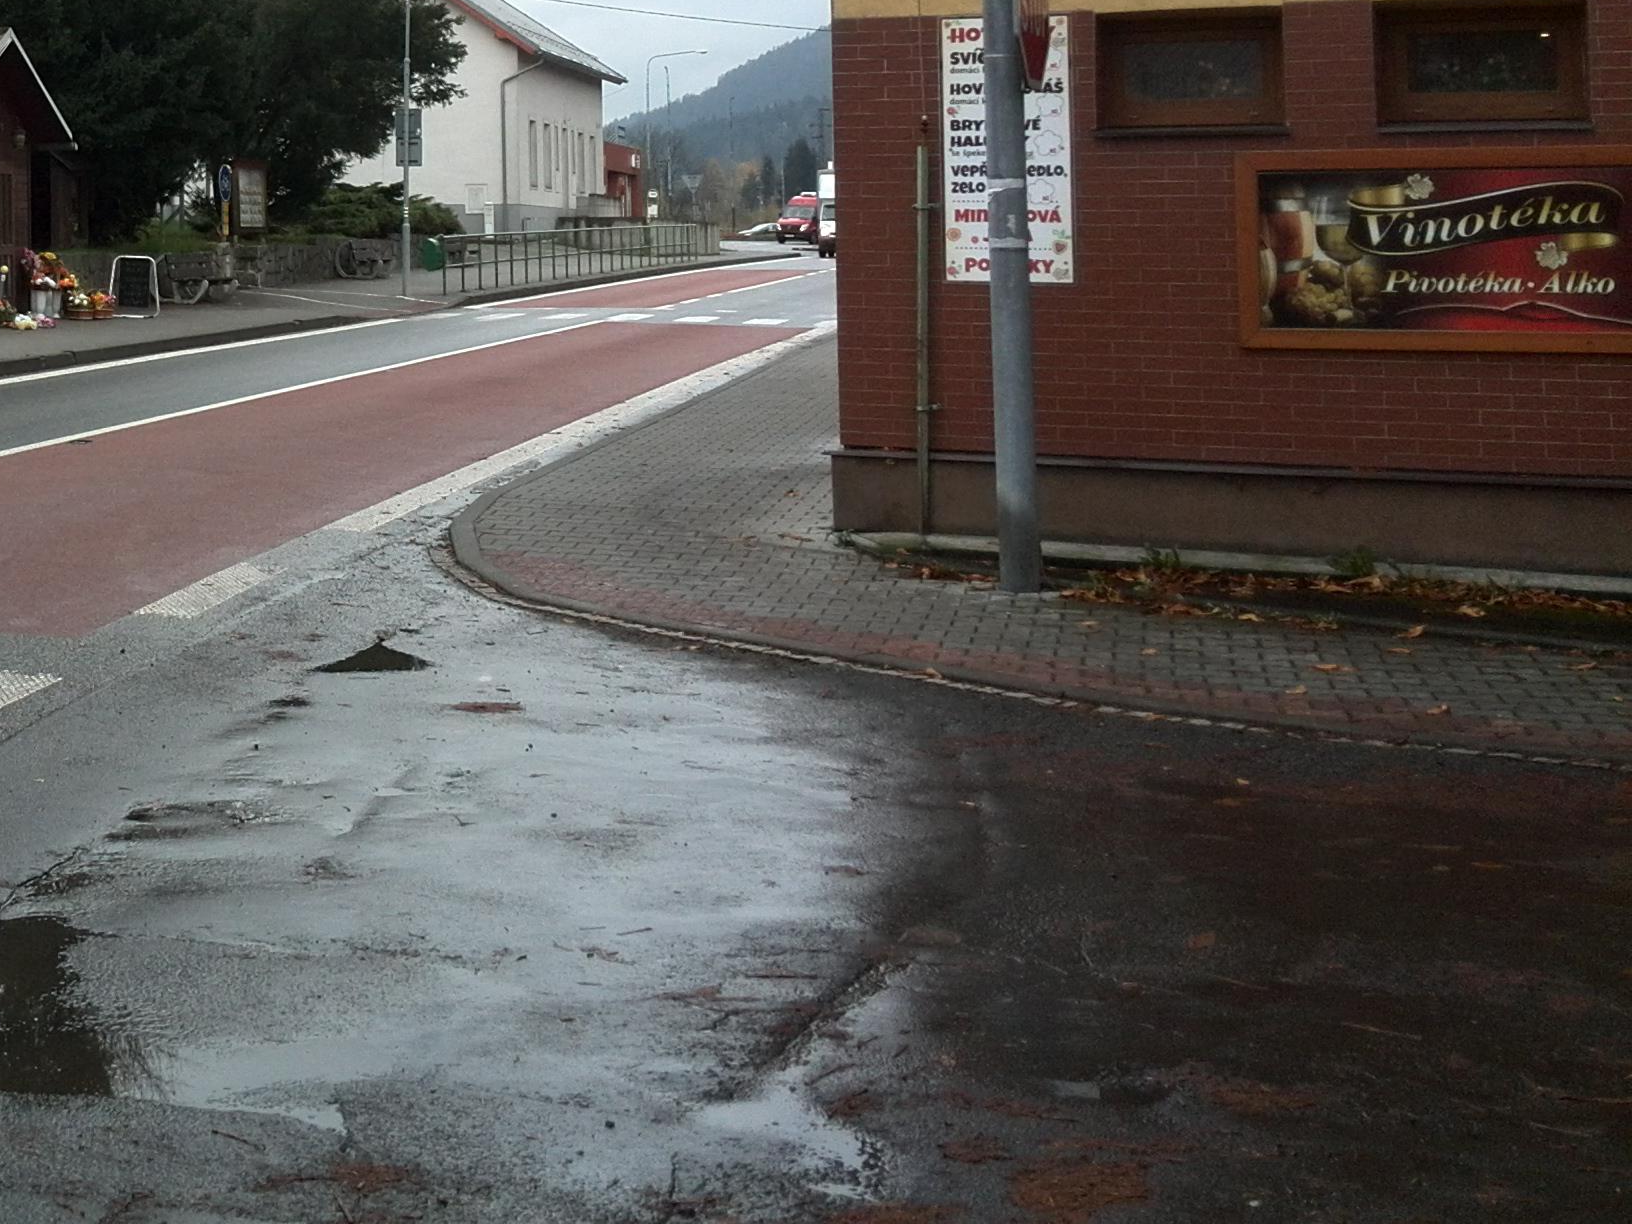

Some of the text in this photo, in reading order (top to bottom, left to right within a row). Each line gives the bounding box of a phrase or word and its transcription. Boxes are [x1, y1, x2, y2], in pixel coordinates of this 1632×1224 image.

[950, 27, 984, 43] HO
[950, 83, 985, 95] HOV
[1358, 195, 1606, 248] Vinotéka
[1380, 268, 1616, 295] Pivotéka Alko
